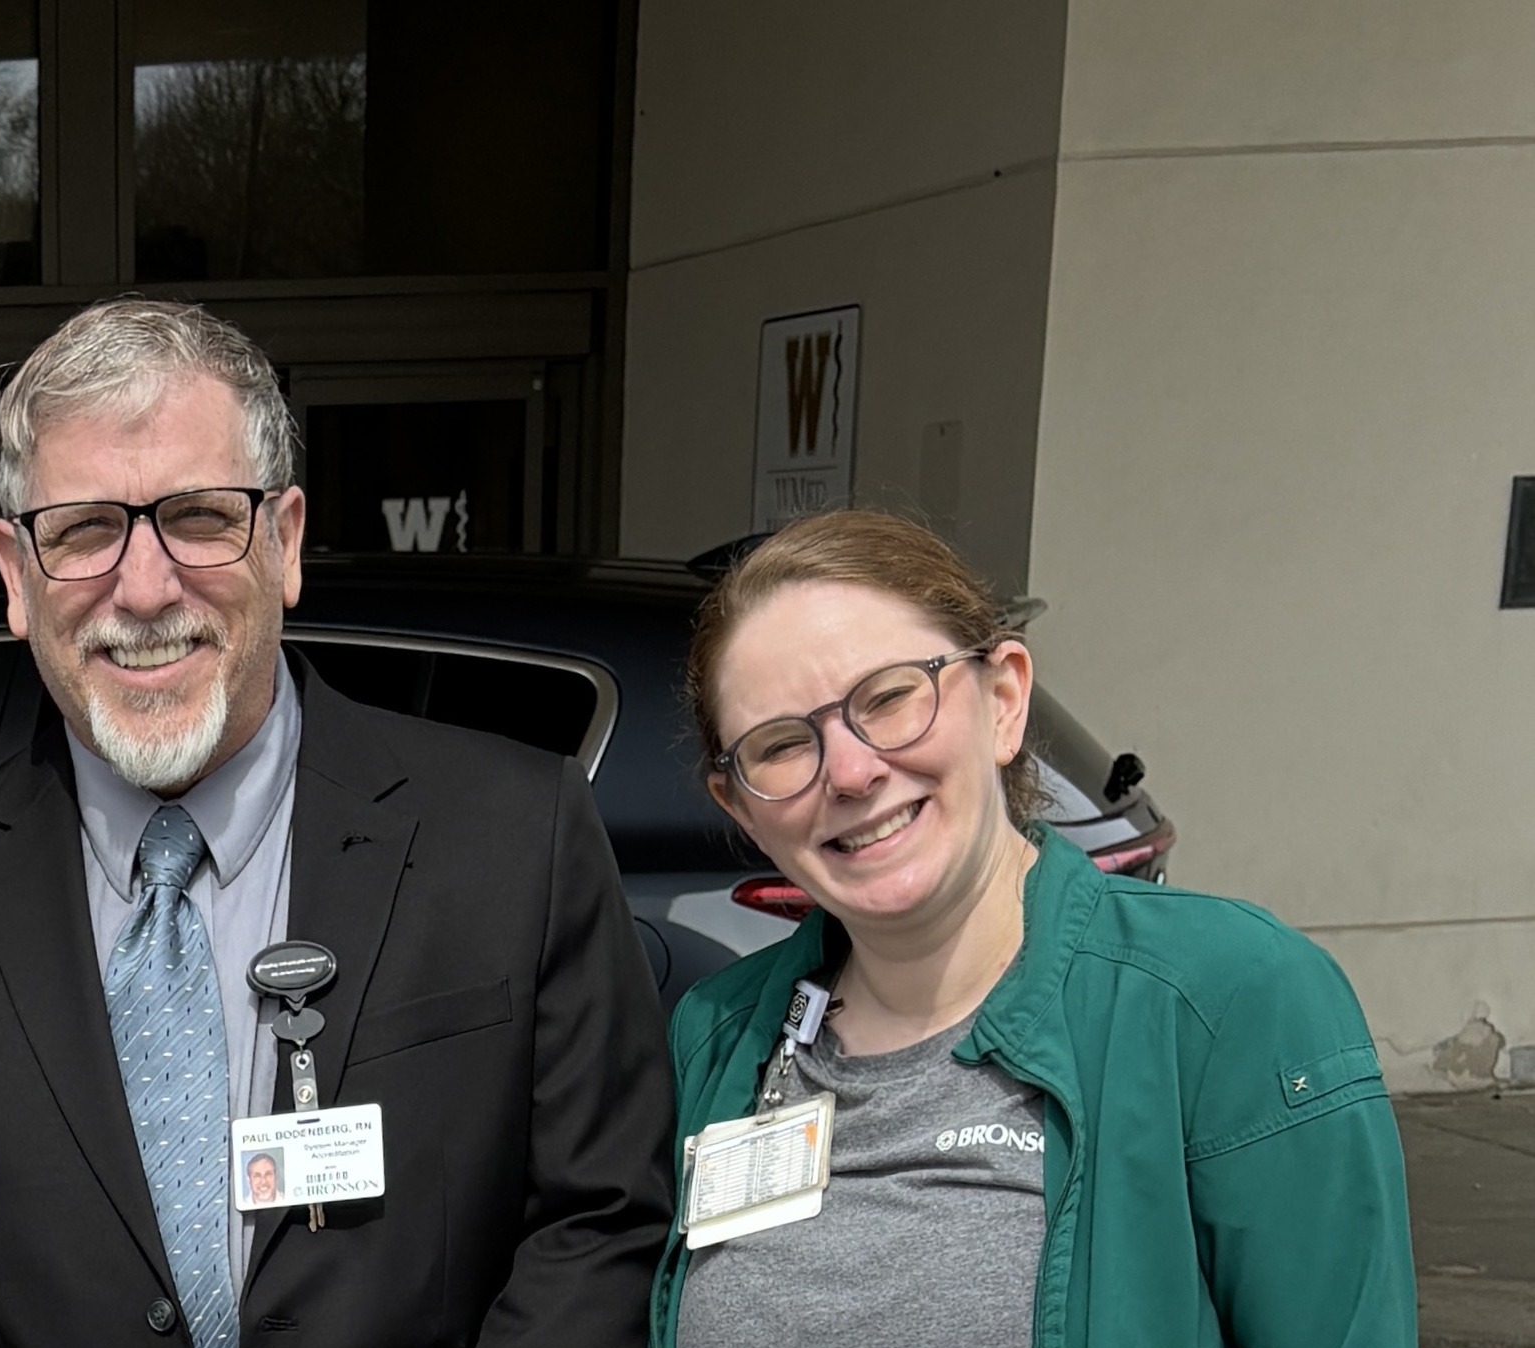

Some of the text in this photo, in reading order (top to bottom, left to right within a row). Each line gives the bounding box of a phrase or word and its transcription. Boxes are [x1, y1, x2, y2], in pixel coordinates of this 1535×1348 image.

[785, 334, 831, 458] W
[382, 496, 451, 553] W
[243, 1134, 271, 1144] PAUL
[356, 1122, 372, 1130] RN
[307, 1180, 379, 1196] BRONSON
